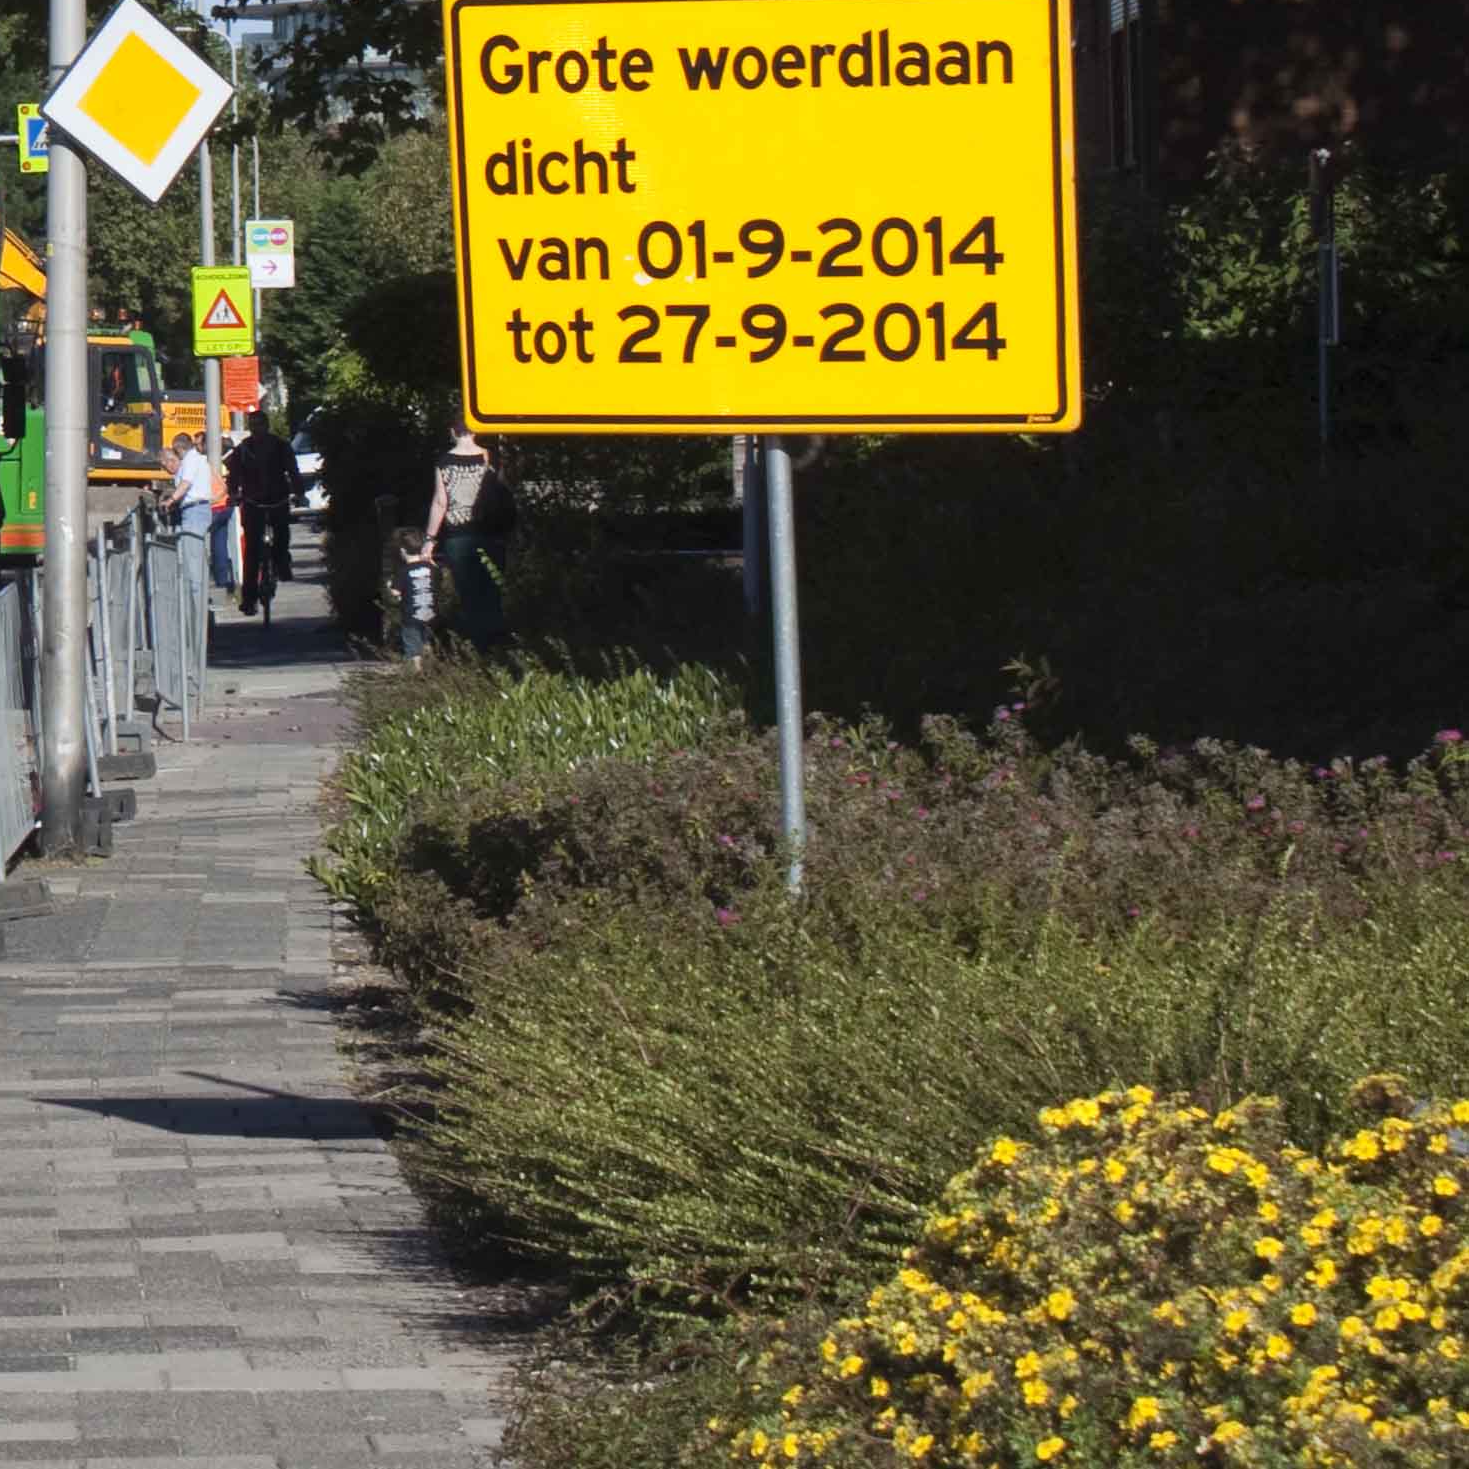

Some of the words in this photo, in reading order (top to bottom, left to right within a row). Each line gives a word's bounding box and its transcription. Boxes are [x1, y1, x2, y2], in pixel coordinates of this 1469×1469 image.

[480, 34, 654, 95] Grote
[678, 29, 1013, 91] woerdlaan
[485, 138, 636, 196] dicht
[498, 237, 610, 281] van
[638, 216, 1004, 280] 01-9-2014
[506, 309, 594, 365] tot
[618, 302, 1007, 363] 27-9-2014
